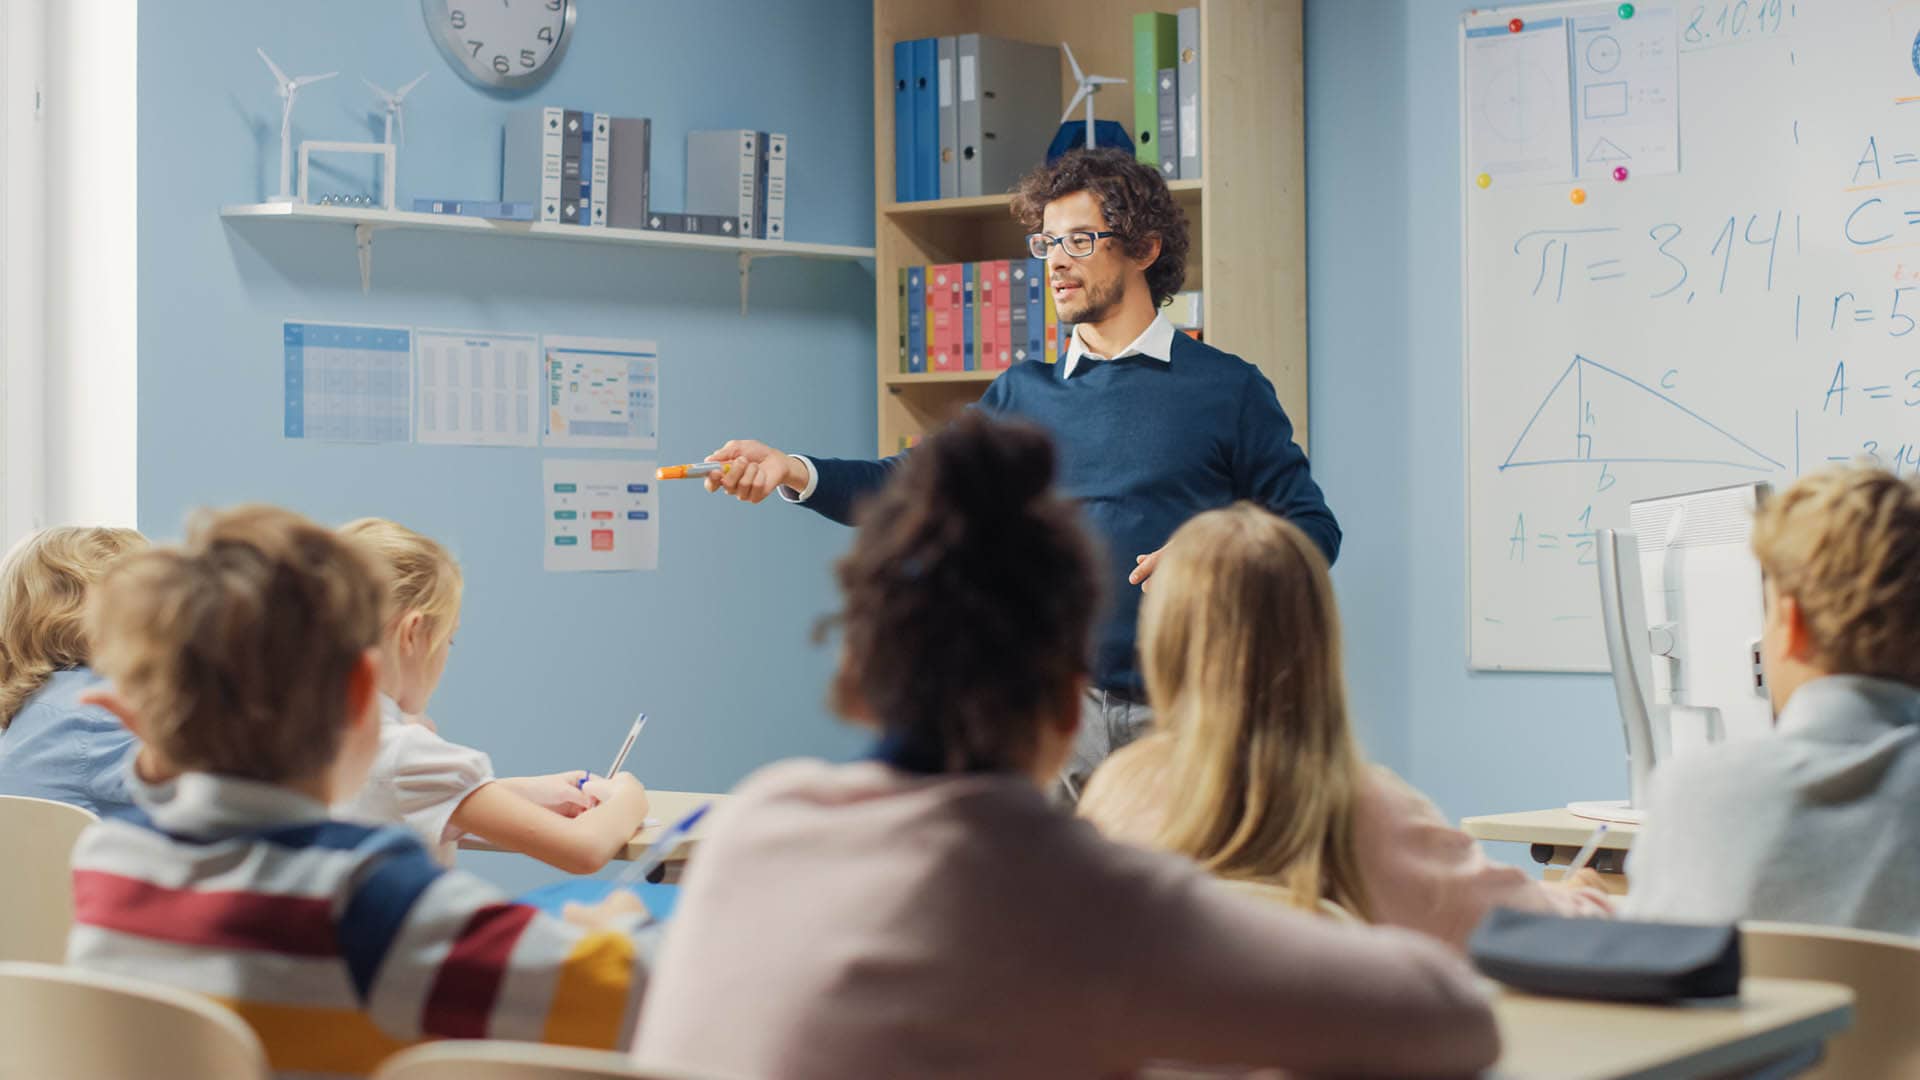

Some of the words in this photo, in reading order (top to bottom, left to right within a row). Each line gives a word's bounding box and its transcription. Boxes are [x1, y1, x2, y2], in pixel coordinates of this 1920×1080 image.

[450, 10, 466, 29] 8
[537, 26, 553, 45] 4
[467, 40, 484, 58] 7
[519, 49, 536, 68] 5
[493, 55, 510, 74] 6
